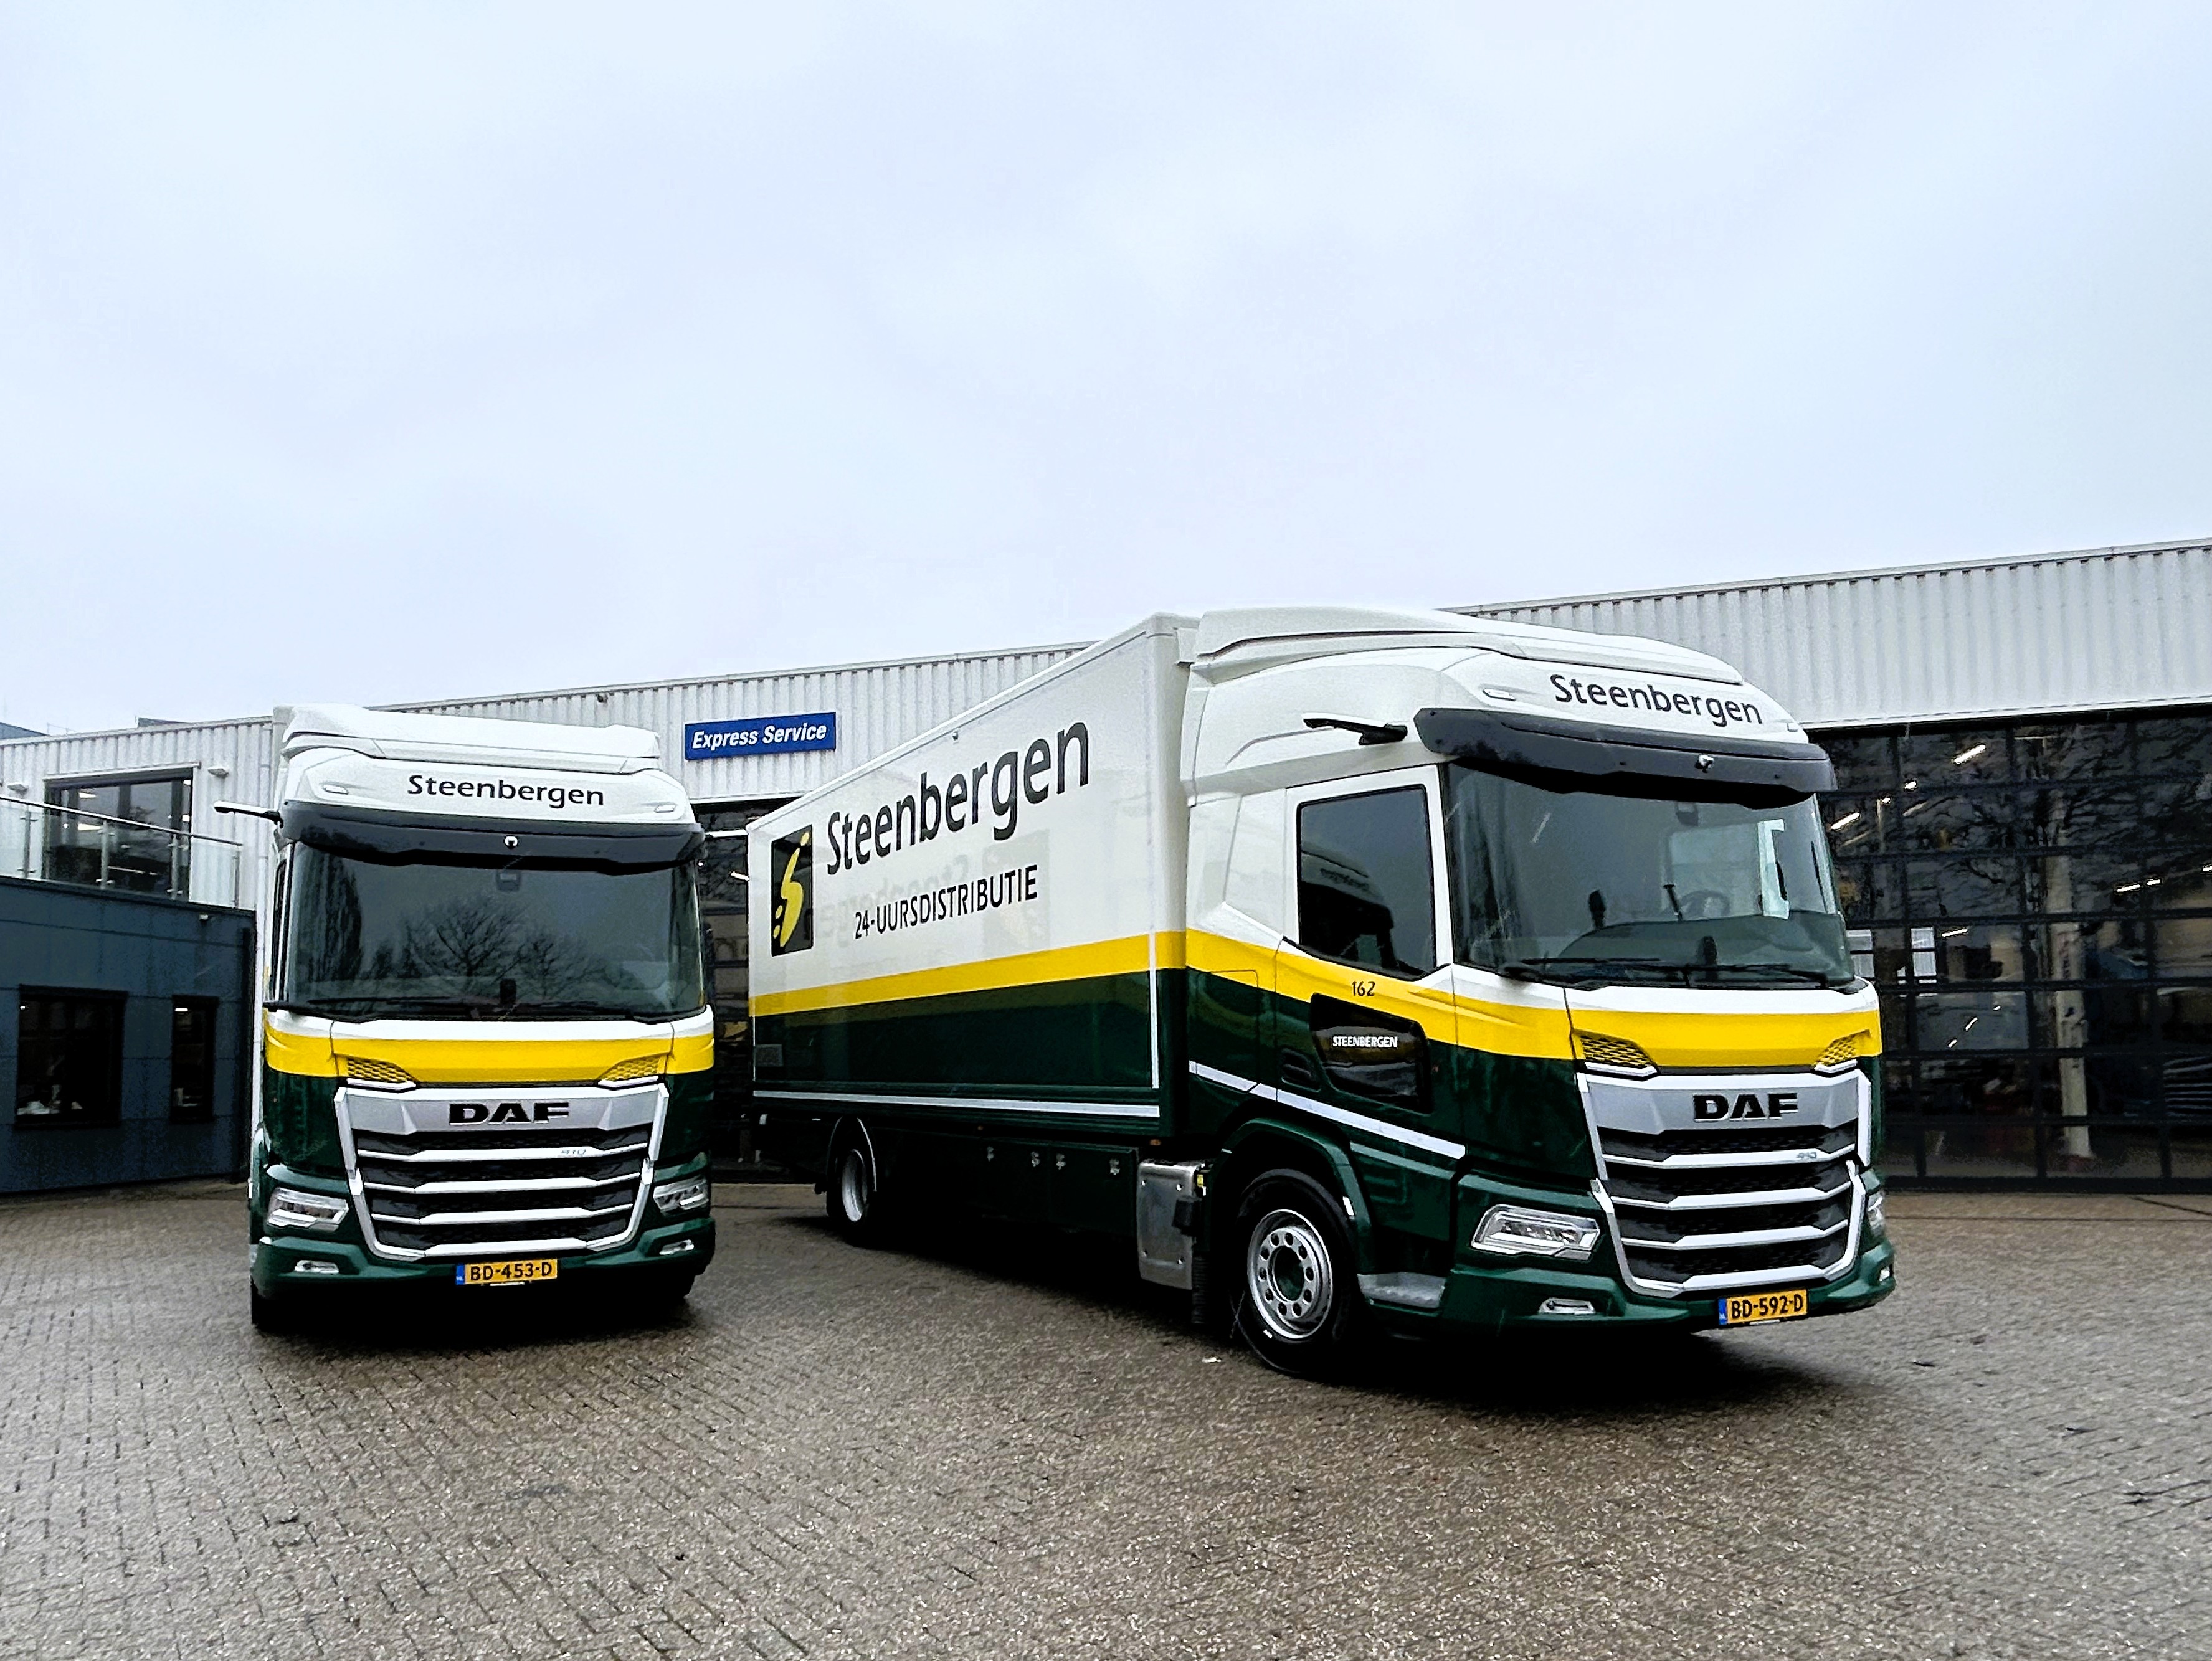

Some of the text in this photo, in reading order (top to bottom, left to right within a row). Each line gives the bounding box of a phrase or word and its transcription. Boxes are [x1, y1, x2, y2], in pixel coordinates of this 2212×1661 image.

[1550, 674, 1762, 727] Steenbergen
[692, 722, 827, 750] Express Service
[407, 775, 604, 808] Steenbergen
[827, 722, 1089, 875] Steenbergen
[855, 864, 1037, 939] 24-UURSDISTRIBUTIE
[1351, 980, 1376, 996] 162
[1332, 1036, 1398, 1048] STEENBERGEN
[449, 1102, 569, 1125] DAF
[1693, 1093, 1798, 1122] DAF
[470, 1262, 552, 1281] BD-453-D
[1731, 1294, 1803, 1319] BD-592-D
